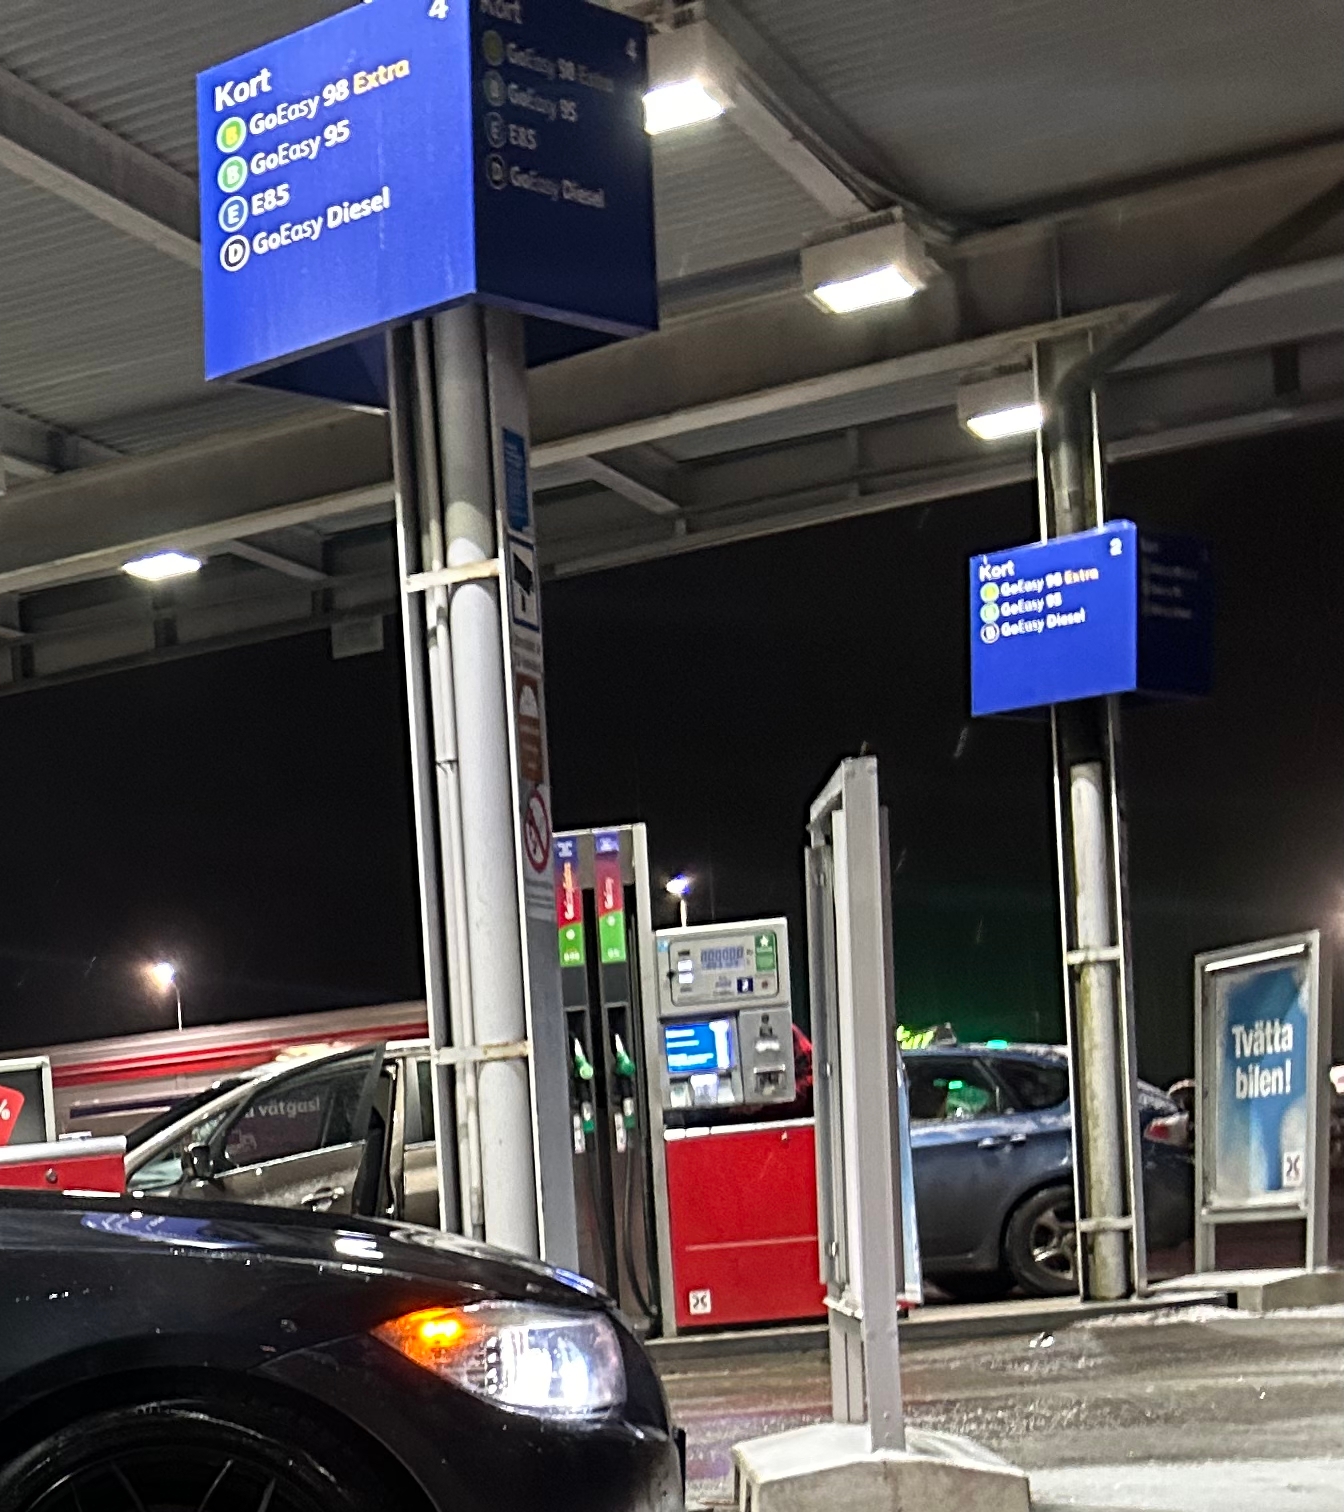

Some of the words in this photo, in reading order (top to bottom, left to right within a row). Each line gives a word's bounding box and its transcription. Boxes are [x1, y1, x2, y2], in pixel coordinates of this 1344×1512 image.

[427, 0, 449, 19] 4
[214, 68, 272, 112] Kort
[249, 95, 321, 135] GoEasy
[322, 79, 350, 107] 98
[353, 59, 410, 94] Extra
[250, 136, 321, 175] GoEasy
[323, 119, 350, 148] 95
[251, 183, 290, 217] E85
[252, 216, 323, 255] GoEasy
[326, 185, 391, 229] Diesel
[1109, 537, 1123, 556] 2
[979, 560, 1015, 582] Kort
[1046, 607, 1086, 629] Diesel
[1231, 1018, 1294, 1059] Tvätta
[1235, 1058, 1292, 1100] bilen!
